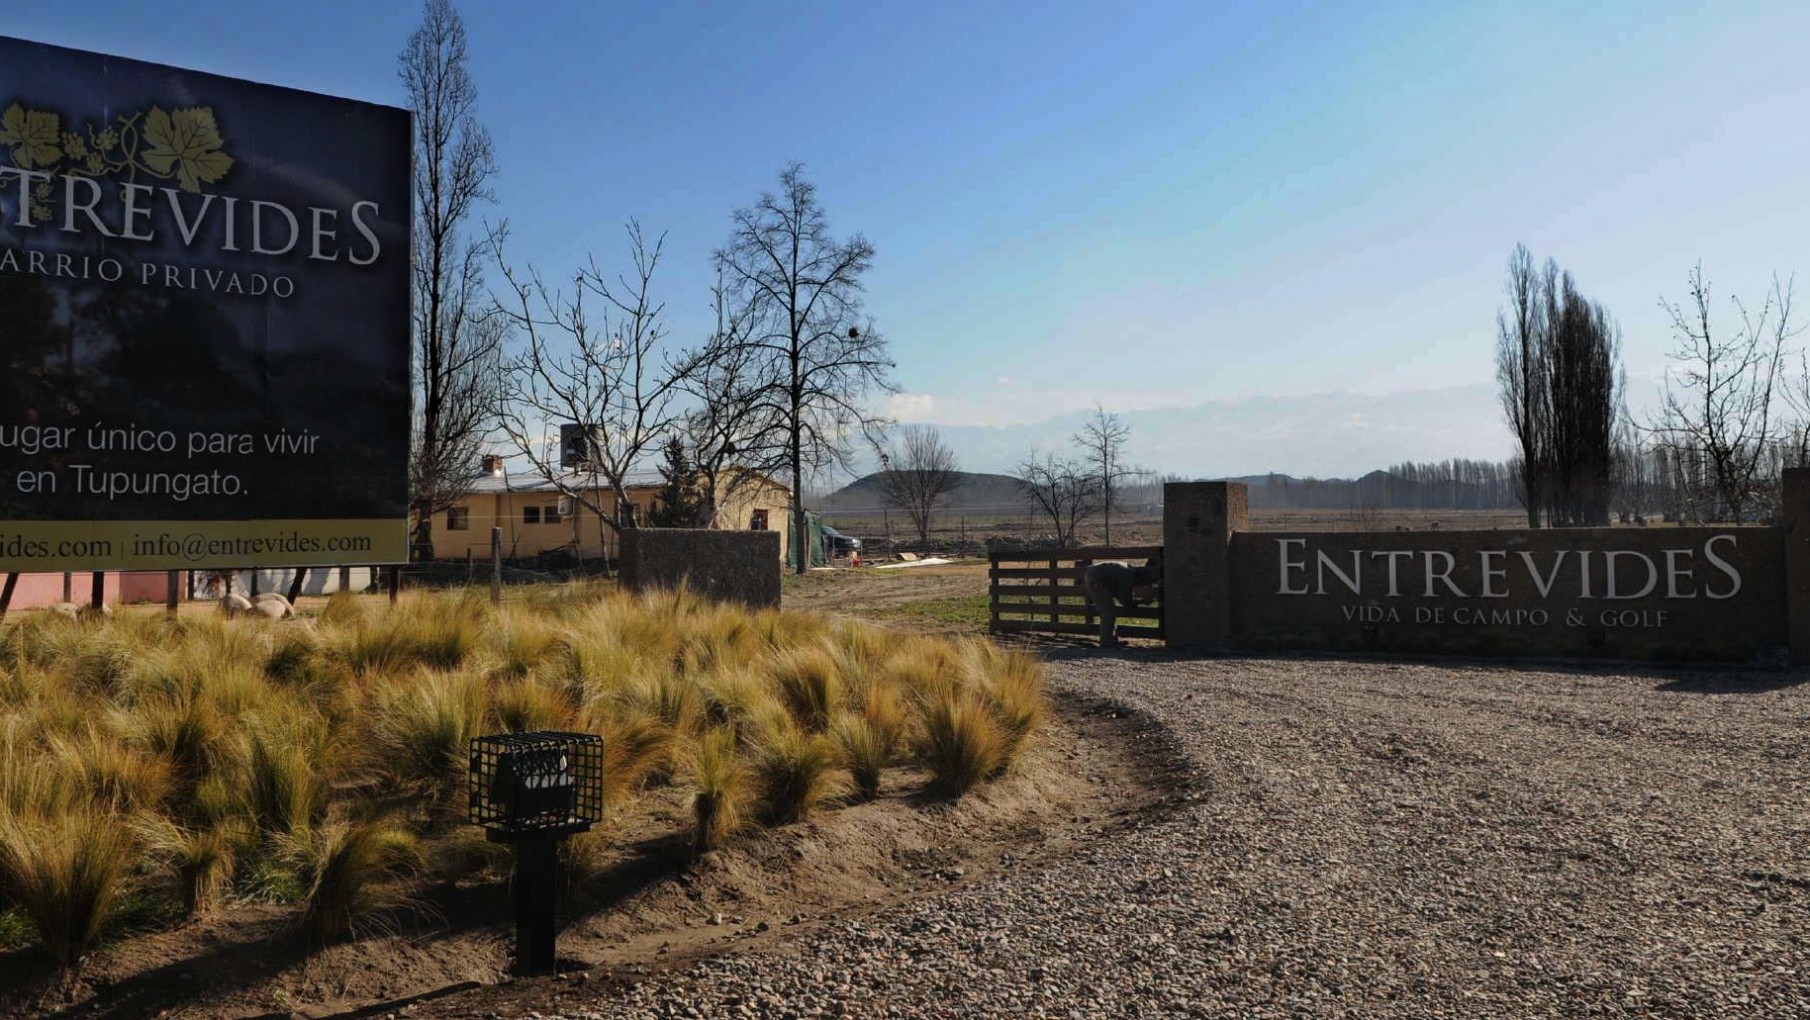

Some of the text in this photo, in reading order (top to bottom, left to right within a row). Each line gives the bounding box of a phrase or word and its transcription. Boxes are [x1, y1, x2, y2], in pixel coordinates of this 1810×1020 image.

[0, 166, 381, 265] TREVIDES
[0, 248, 294, 298] ARRIO PRIVADO
[0, 421, 320, 459] ugar único para vivir
[16, 464, 249, 501] en Tupungato.
[0, 531, 372, 562] ides.com info@entrevides.com
[1341, 604, 1670, 628] VIDA DE CAMPO & GOLF
